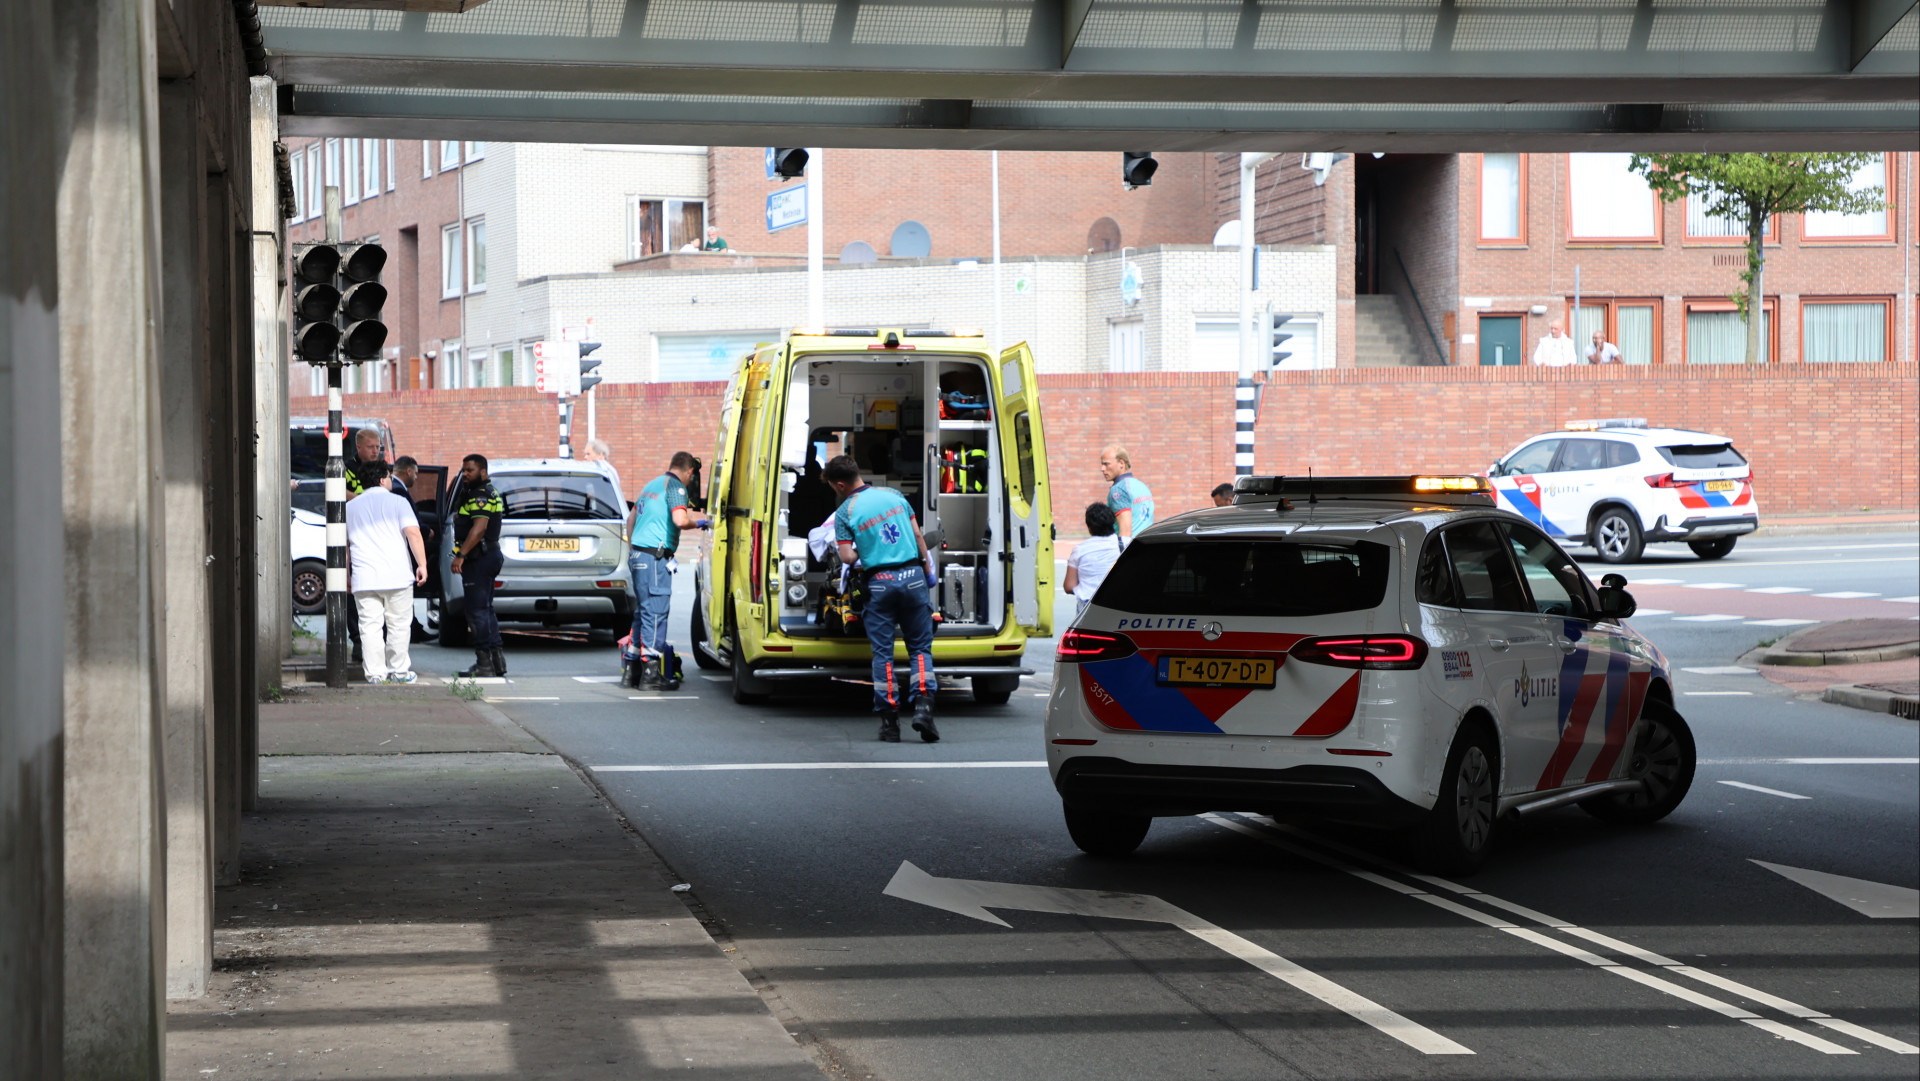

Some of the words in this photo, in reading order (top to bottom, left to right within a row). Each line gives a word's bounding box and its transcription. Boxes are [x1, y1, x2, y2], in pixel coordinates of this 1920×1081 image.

[1544, 484, 1580, 497] POLITIE
[858, 505, 904, 532] AMBULANCE
[529, 539, 575, 549] 7-ZNN-51
[1117, 618, 1198, 629] POLITIE
[1442, 651, 1457, 661] 0900
[1457, 651, 1471, 667] 112
[1175, 660, 1267, 681] T-407-DP
[1443, 662, 1459, 672] 8844
[1090, 682, 1114, 706] 3517
[1515, 678, 1557, 707] POLITIE
